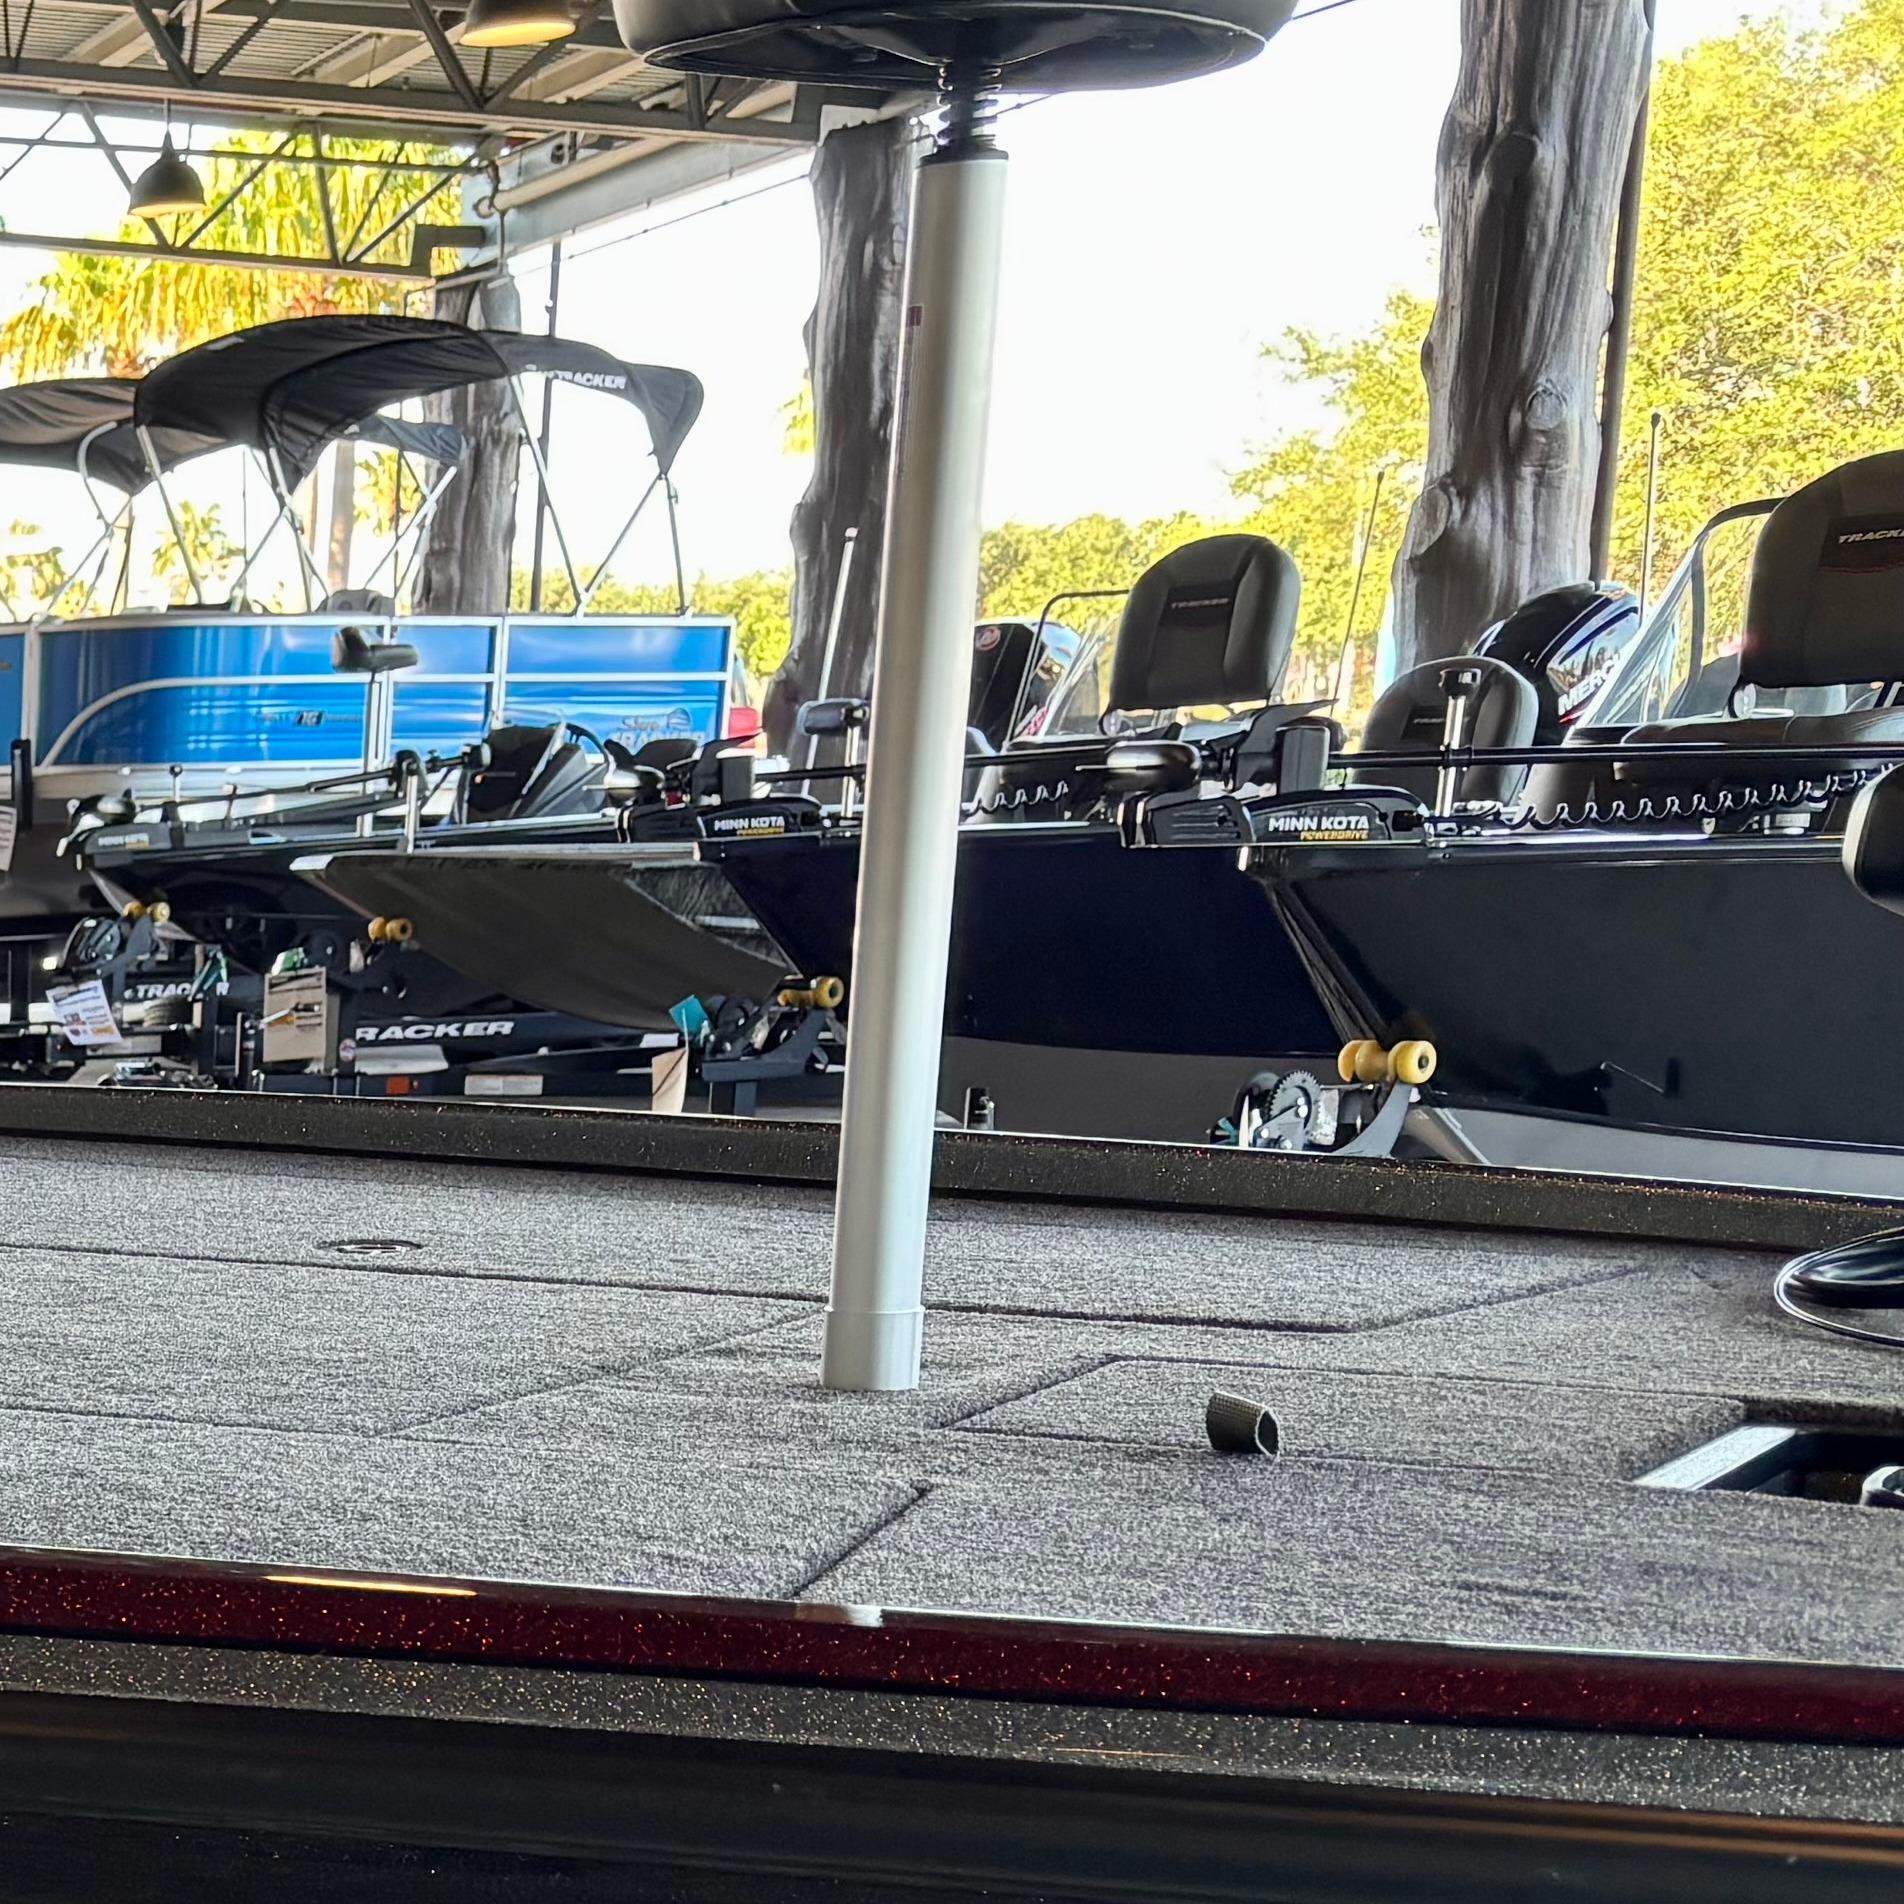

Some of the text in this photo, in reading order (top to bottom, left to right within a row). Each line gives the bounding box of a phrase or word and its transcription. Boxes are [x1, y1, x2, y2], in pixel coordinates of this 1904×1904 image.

[554, 369, 627, 390] TRACKER
[1838, 529, 1904, 544] TRACK
[1557, 652, 1622, 716] MERC
[714, 815, 785, 831] MINN KOTA
[1268, 815, 1369, 831] MINN KOTA
[355, 1021, 515, 1042] RACKER
